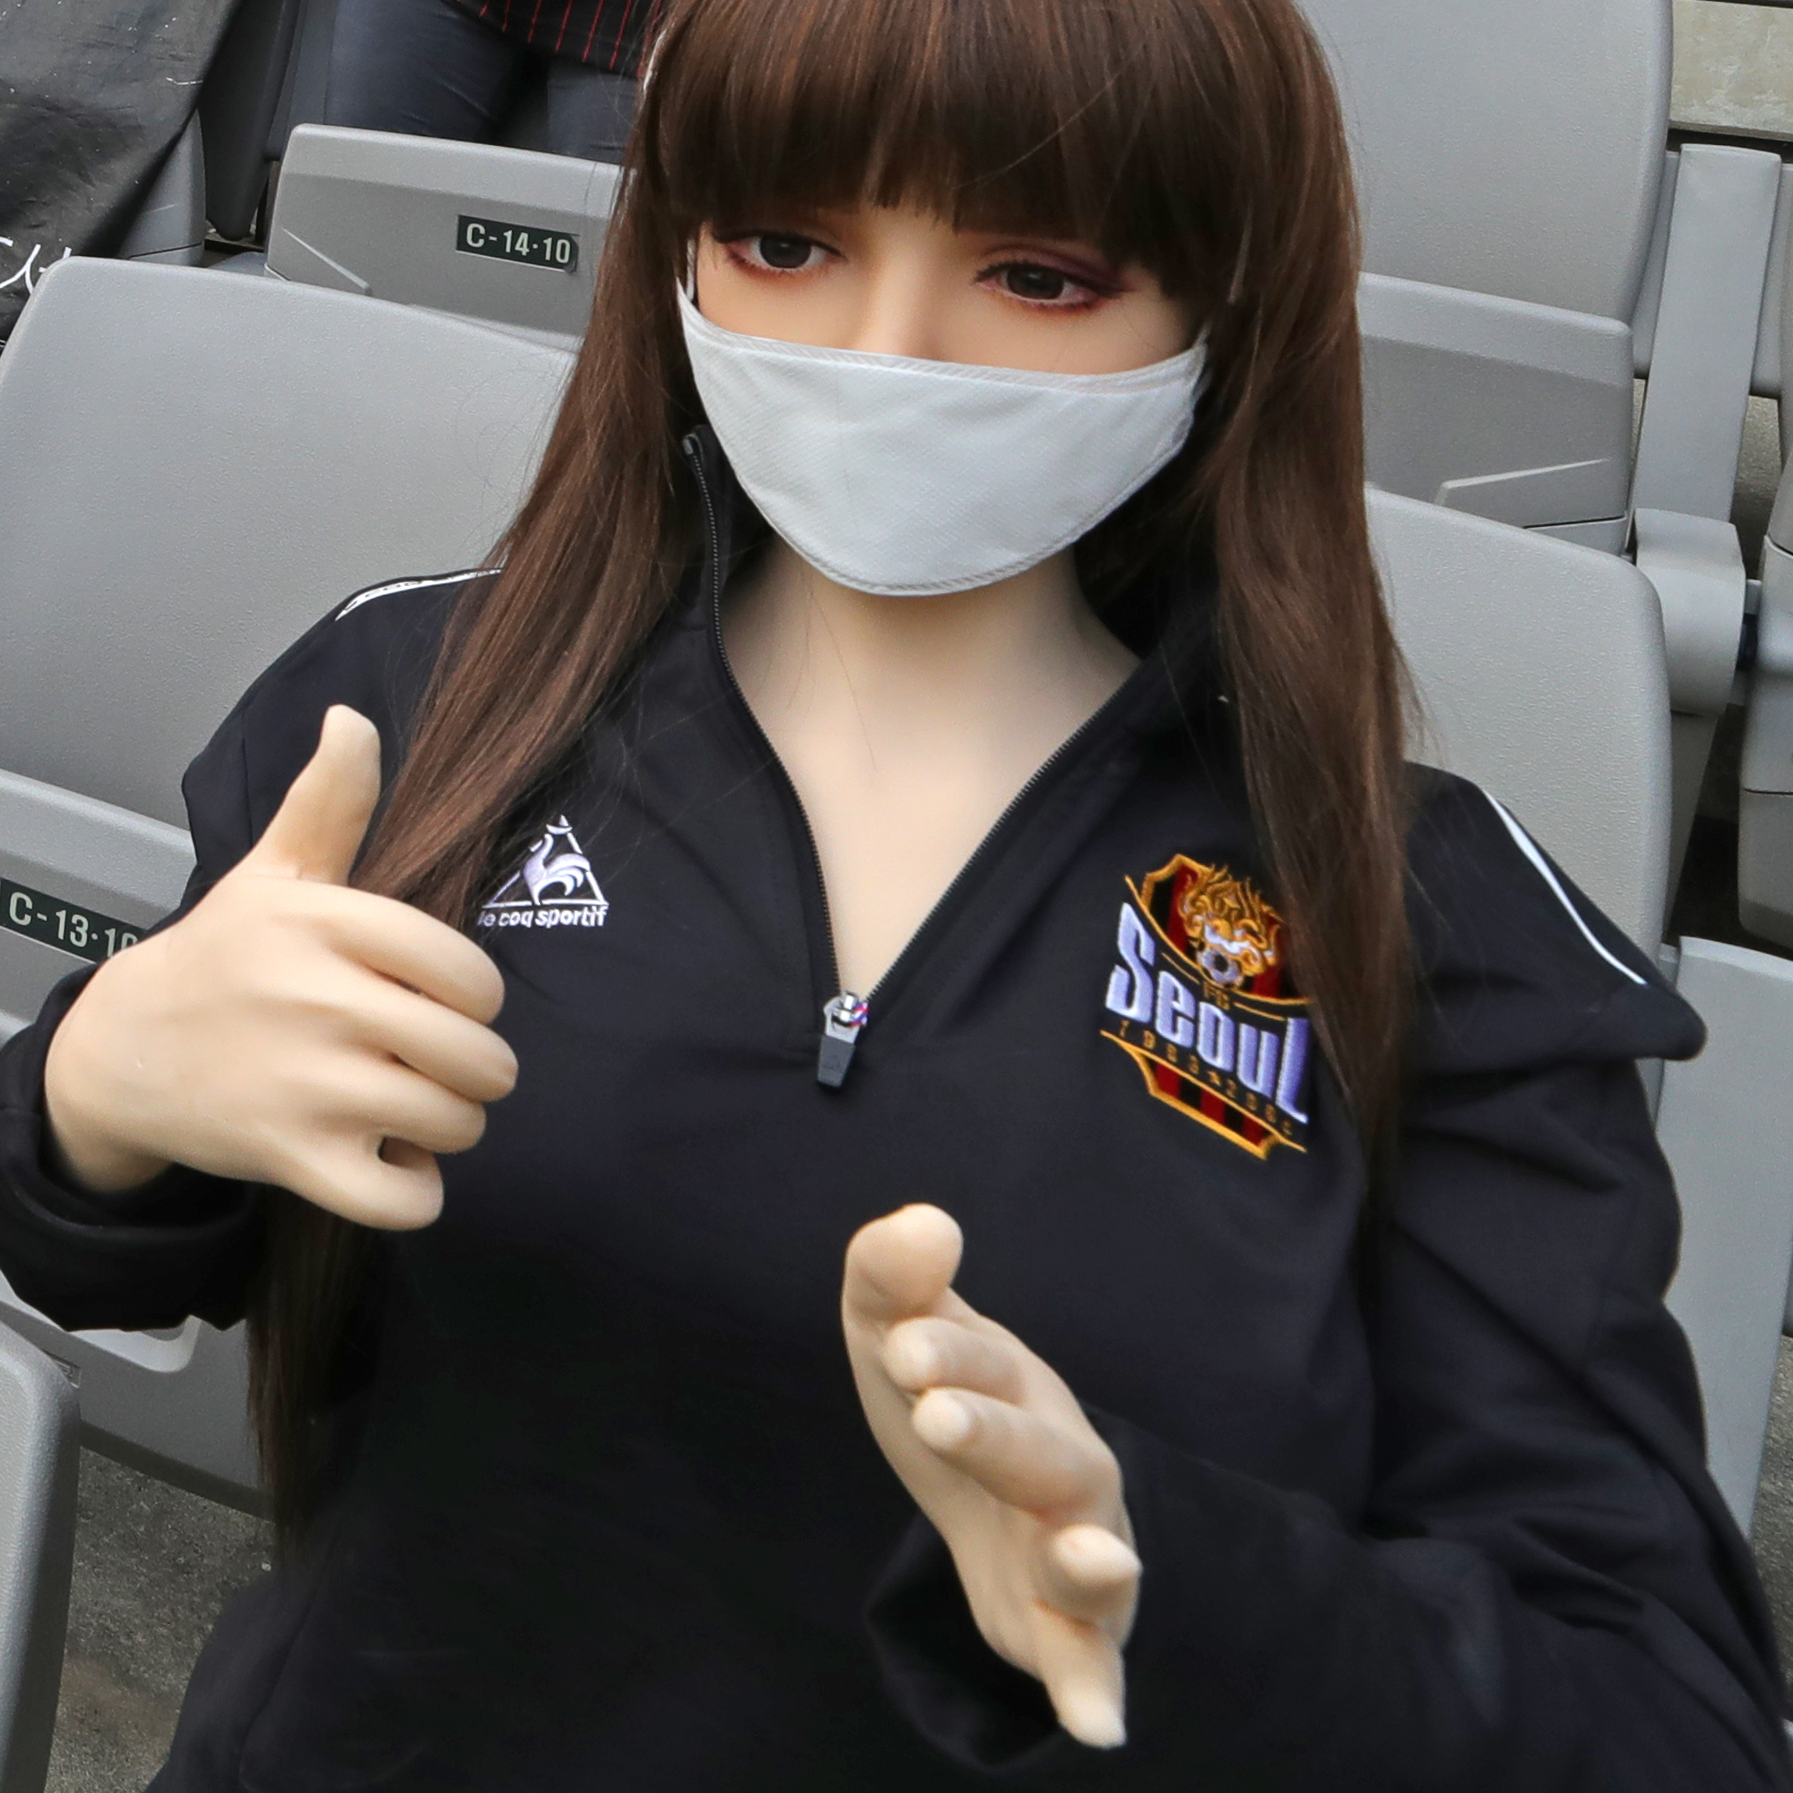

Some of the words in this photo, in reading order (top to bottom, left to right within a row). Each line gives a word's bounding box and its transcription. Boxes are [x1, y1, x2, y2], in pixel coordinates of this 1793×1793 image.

[498, 909, 534, 929] coq
[535, 905, 608, 929] sportif
[1105, 901, 1310, 1124] Seoul
